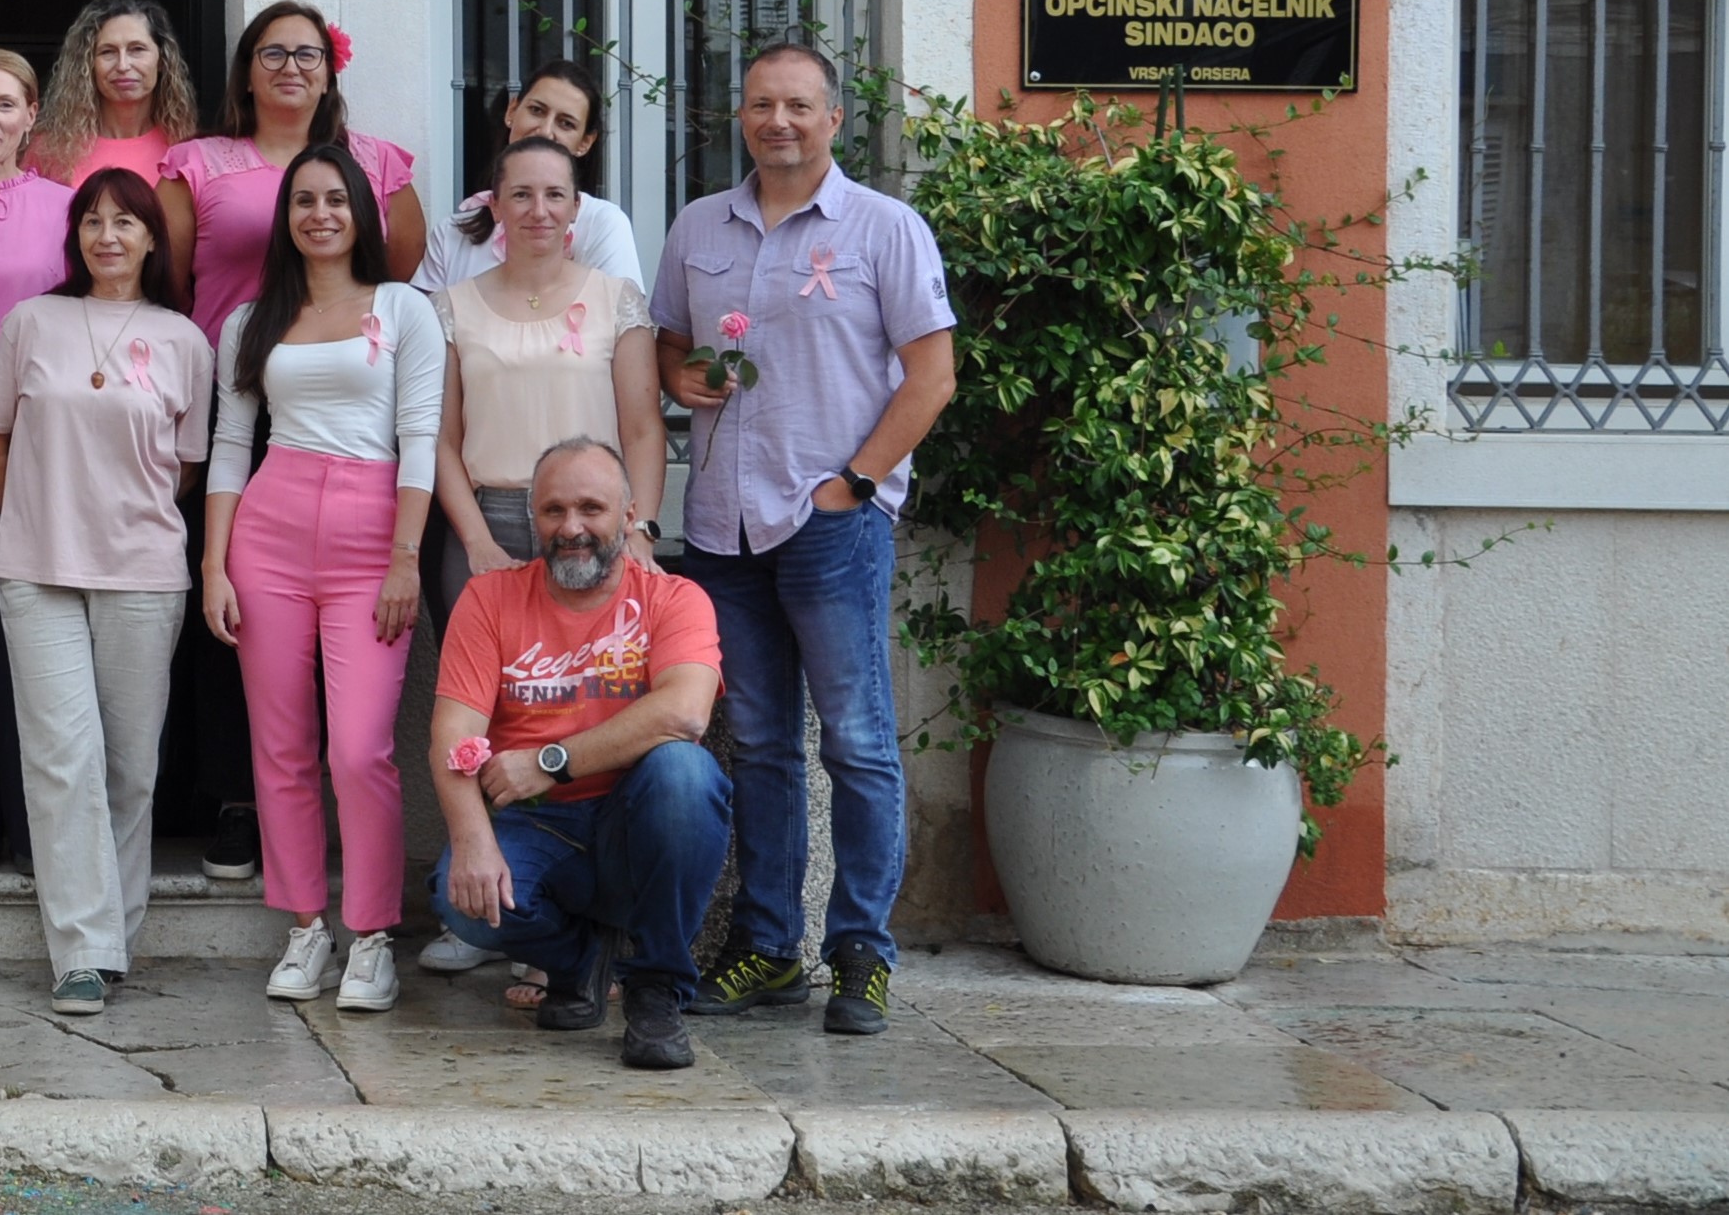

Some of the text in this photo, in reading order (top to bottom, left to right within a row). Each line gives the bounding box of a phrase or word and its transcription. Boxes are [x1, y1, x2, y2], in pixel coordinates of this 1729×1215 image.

[1125, 21, 1254, 47] SINDACO
[1191, 67, 1251, 81] ORSERA
[502, 623, 651, 680] Leges
